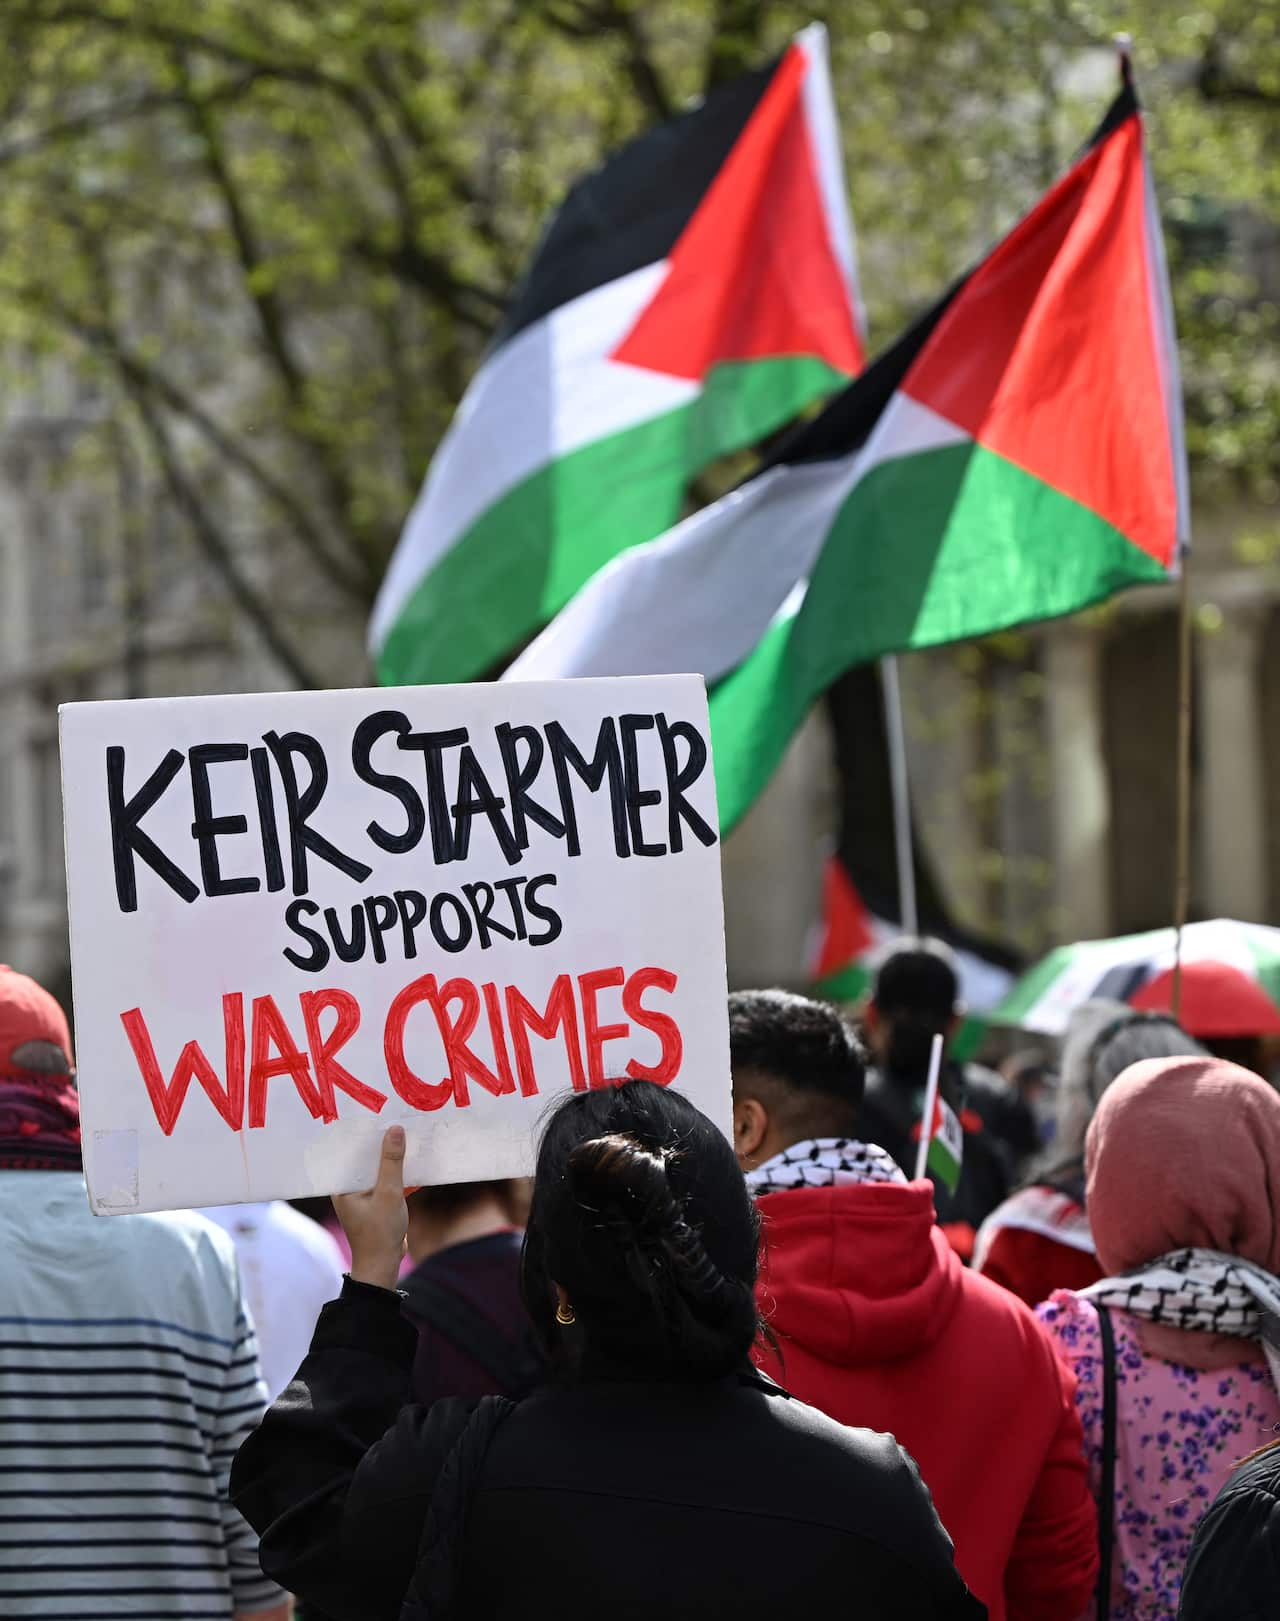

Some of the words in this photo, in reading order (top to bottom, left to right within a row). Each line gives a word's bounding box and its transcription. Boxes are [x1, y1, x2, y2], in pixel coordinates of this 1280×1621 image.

[106, 730, 373, 913] KEIR
[352, 710, 718, 866] STARMER
[283, 873, 563, 973] SUPPORTS
[120, 988, 388, 1137] WAR
[384, 966, 683, 1112] CRIMES
